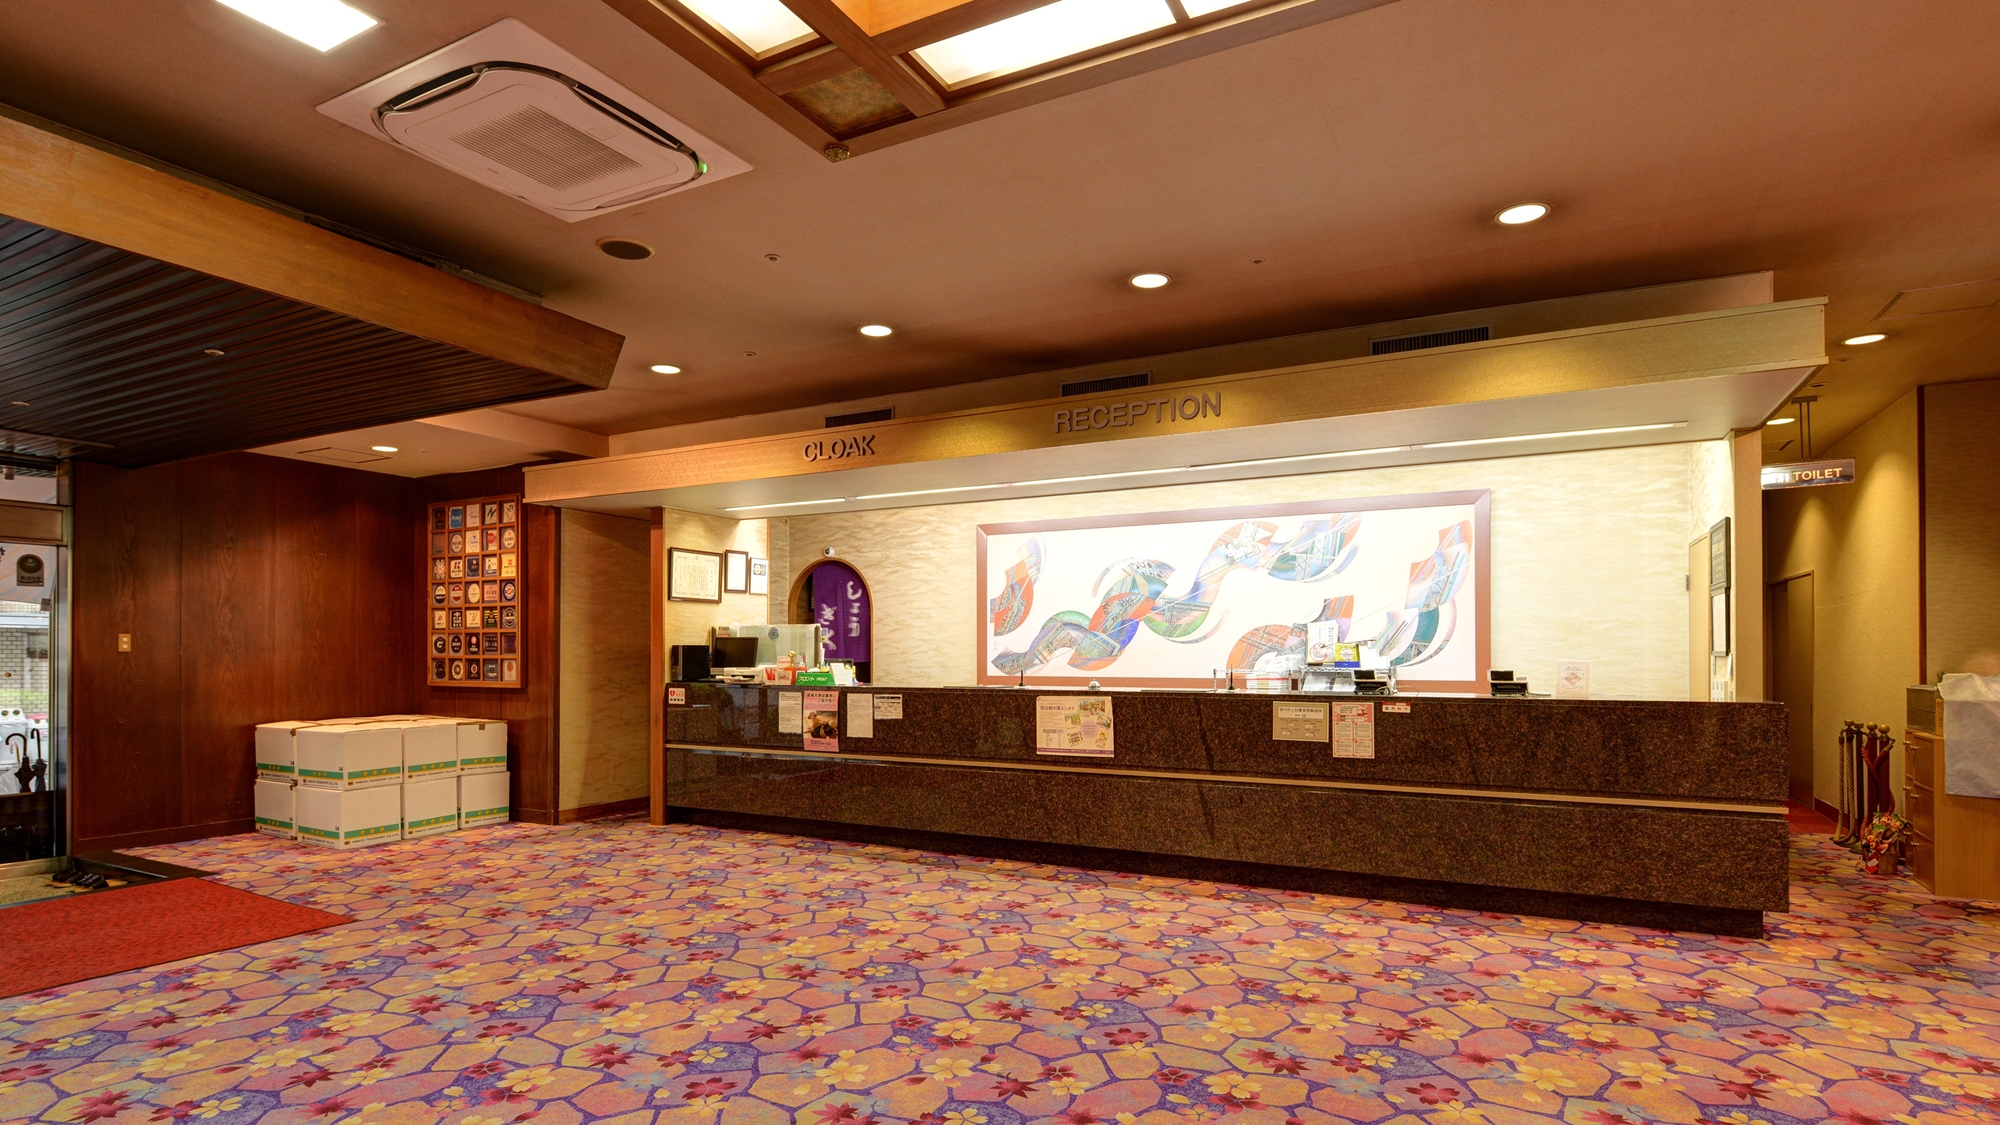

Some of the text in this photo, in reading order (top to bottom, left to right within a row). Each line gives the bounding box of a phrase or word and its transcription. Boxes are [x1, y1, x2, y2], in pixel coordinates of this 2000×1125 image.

[1054, 391, 1221, 434] RECEPTION
[803, 434, 876, 463] CLOAK
[1793, 467, 1843, 481] TOILET
